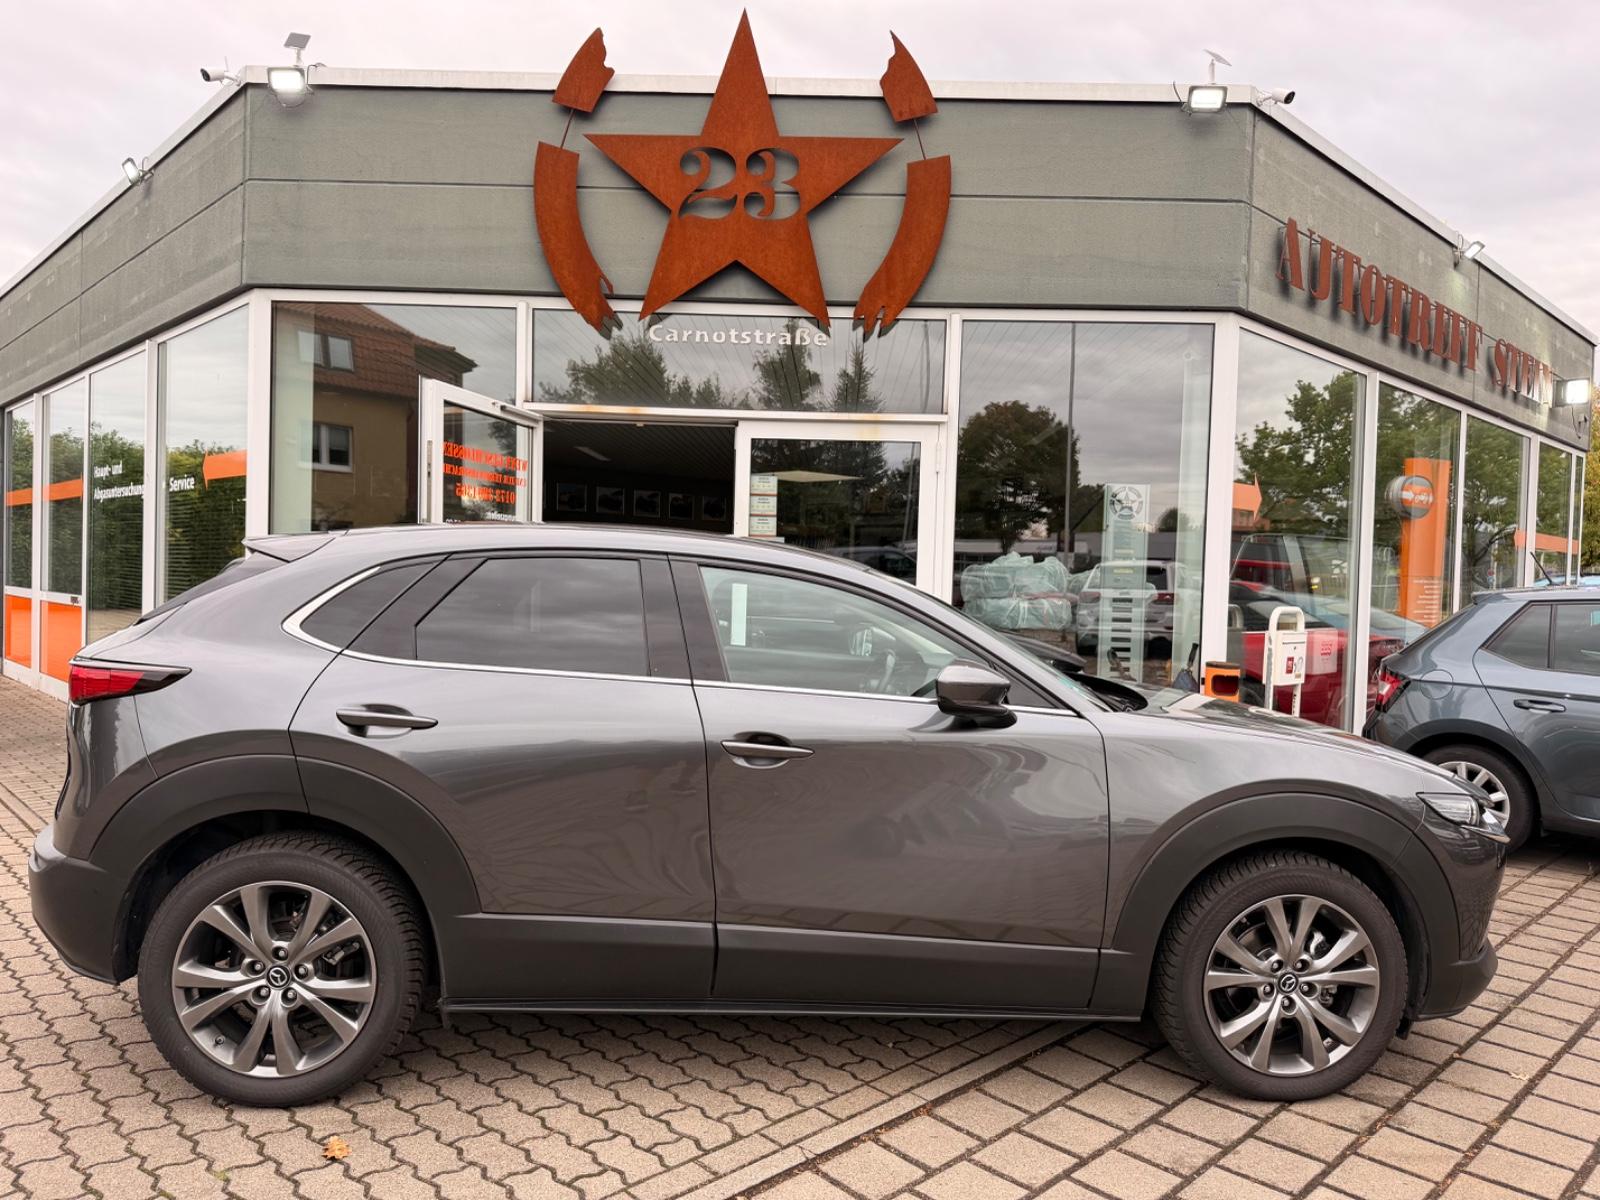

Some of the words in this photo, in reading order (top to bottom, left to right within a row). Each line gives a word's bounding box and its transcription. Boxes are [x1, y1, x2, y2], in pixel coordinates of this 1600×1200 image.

[679, 146, 800, 220] 23
[1275, 216, 1483, 371] AUTOTREFF
[649, 324, 828, 347] Carnotstraße
[112, 460, 123, 475] und
[169, 474, 195, 492] Service
